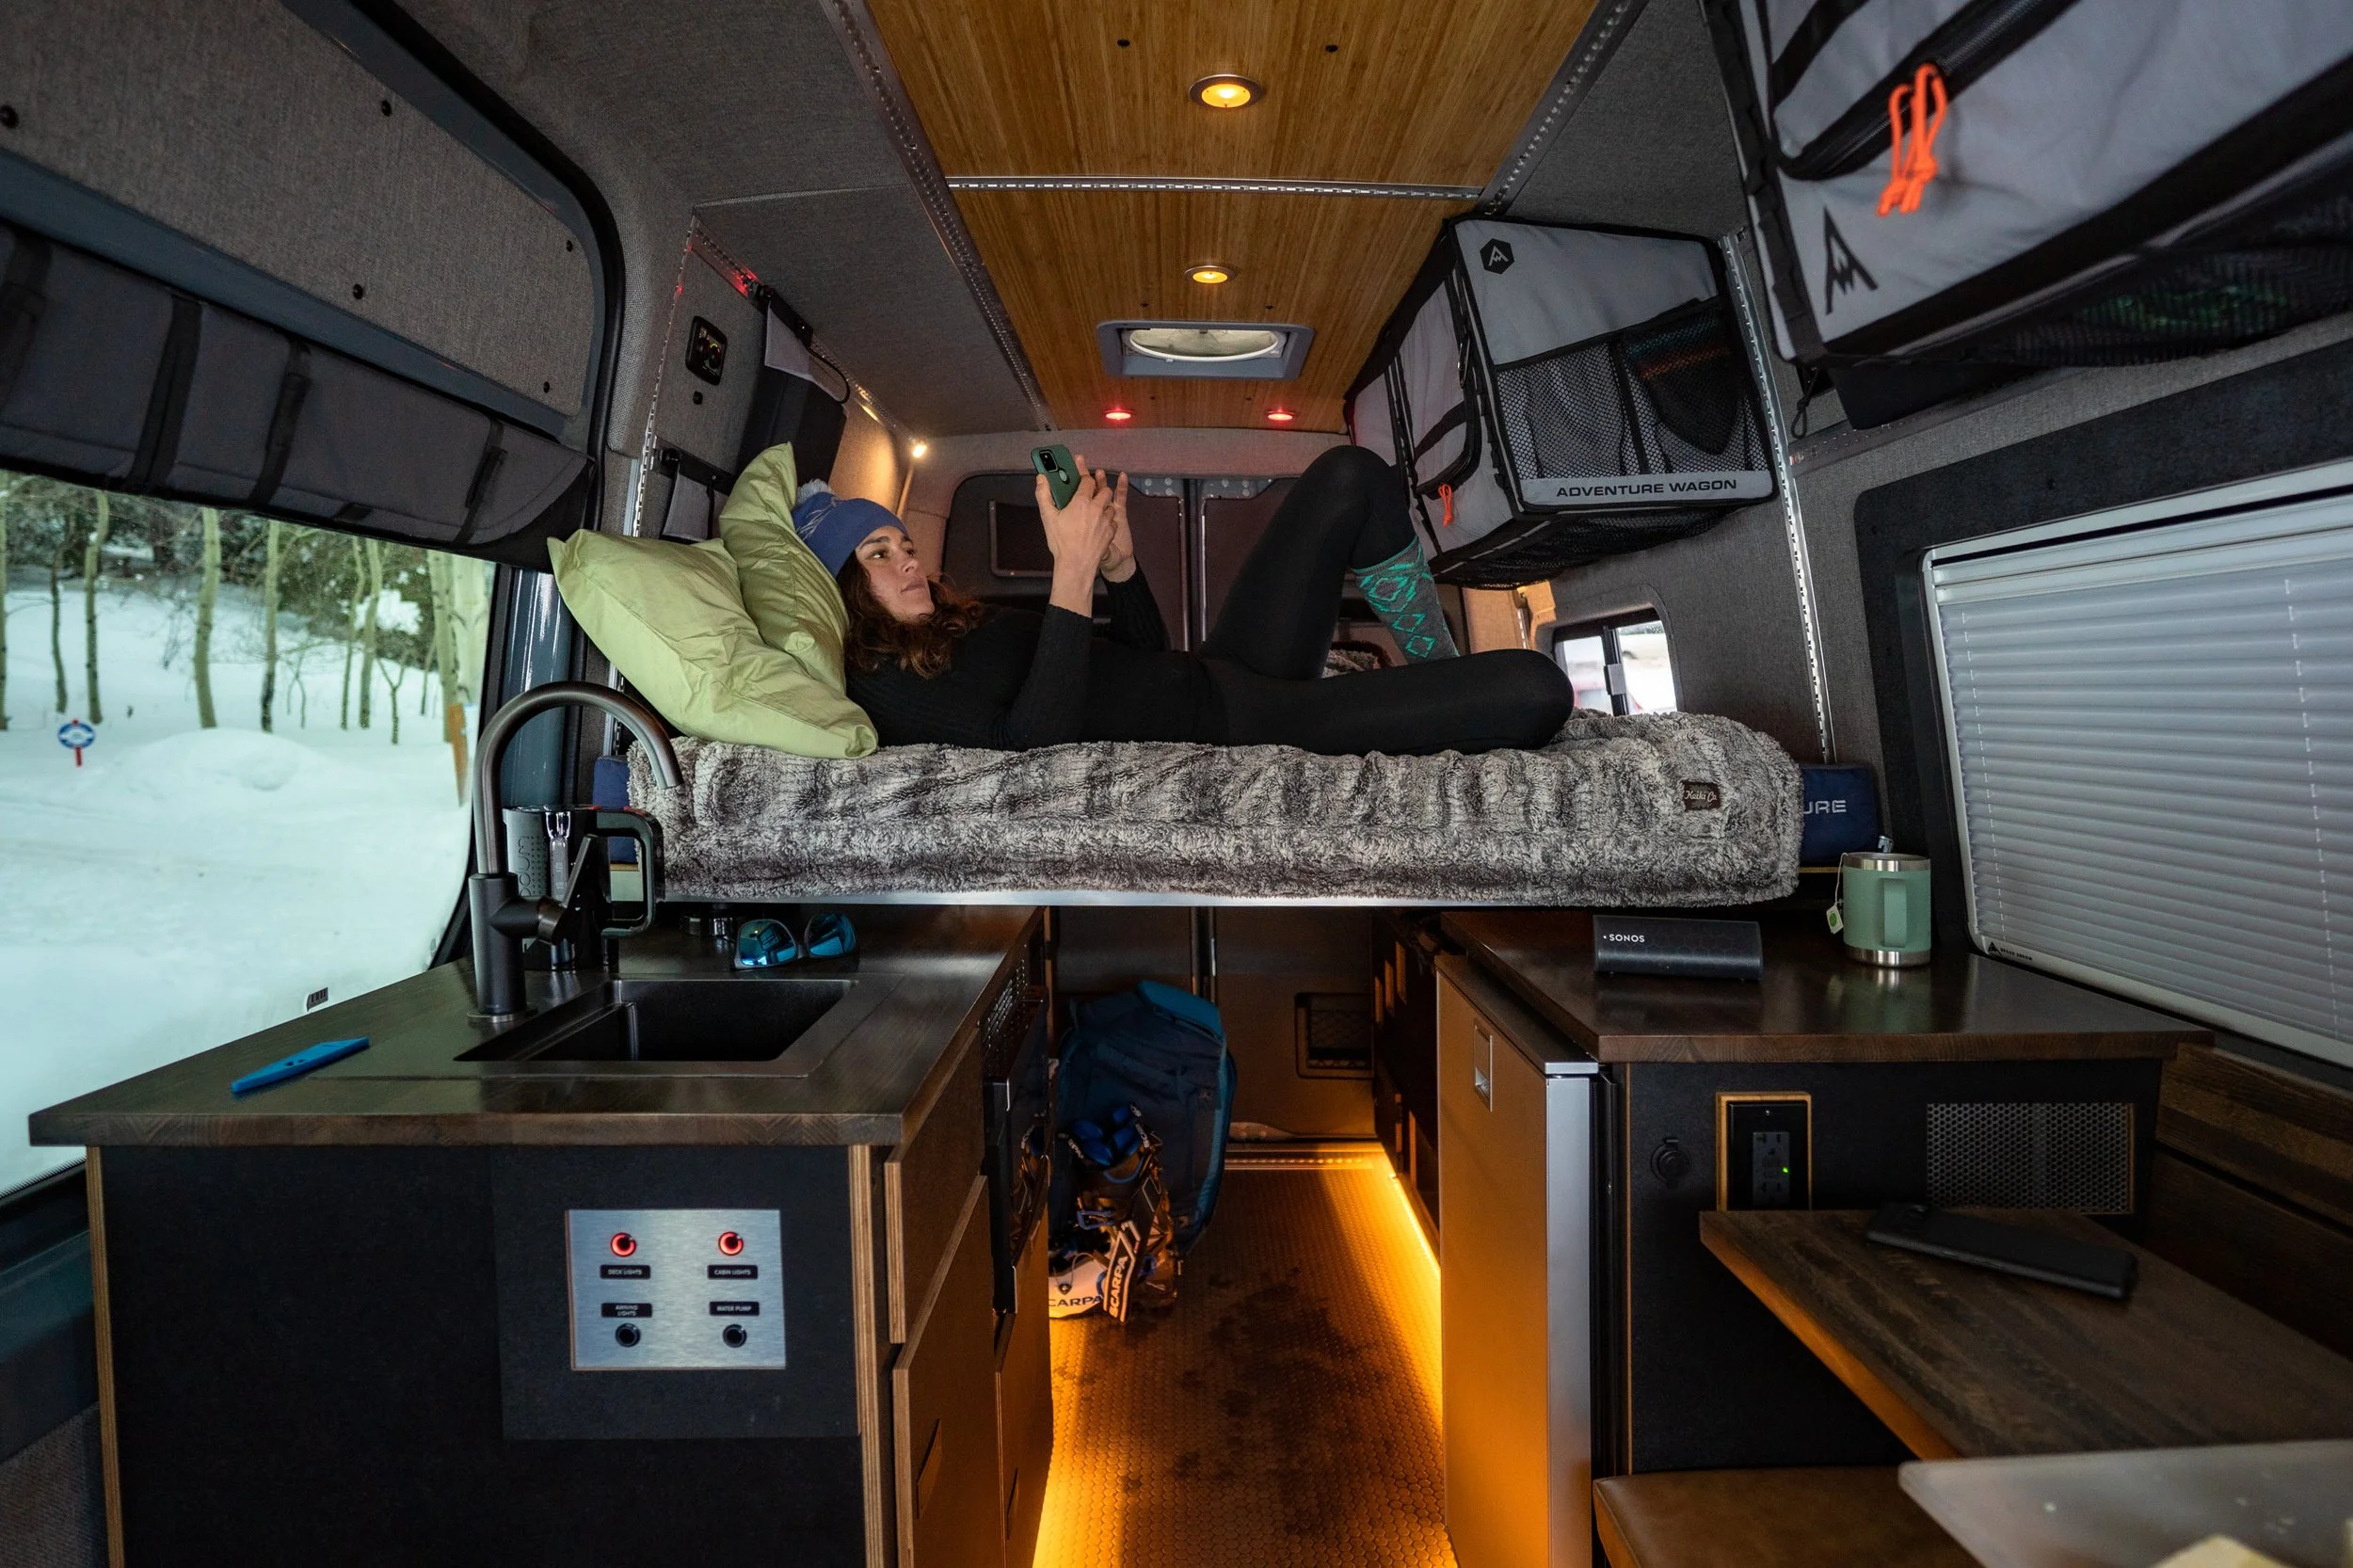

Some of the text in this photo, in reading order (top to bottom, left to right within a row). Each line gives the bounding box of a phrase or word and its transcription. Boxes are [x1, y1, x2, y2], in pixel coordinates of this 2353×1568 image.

[1556, 479, 1737, 497] ADVENTURE WAGON
[1609, 934, 1645, 943] SONOS
[1109, 1256, 1128, 1318] SCARPA
